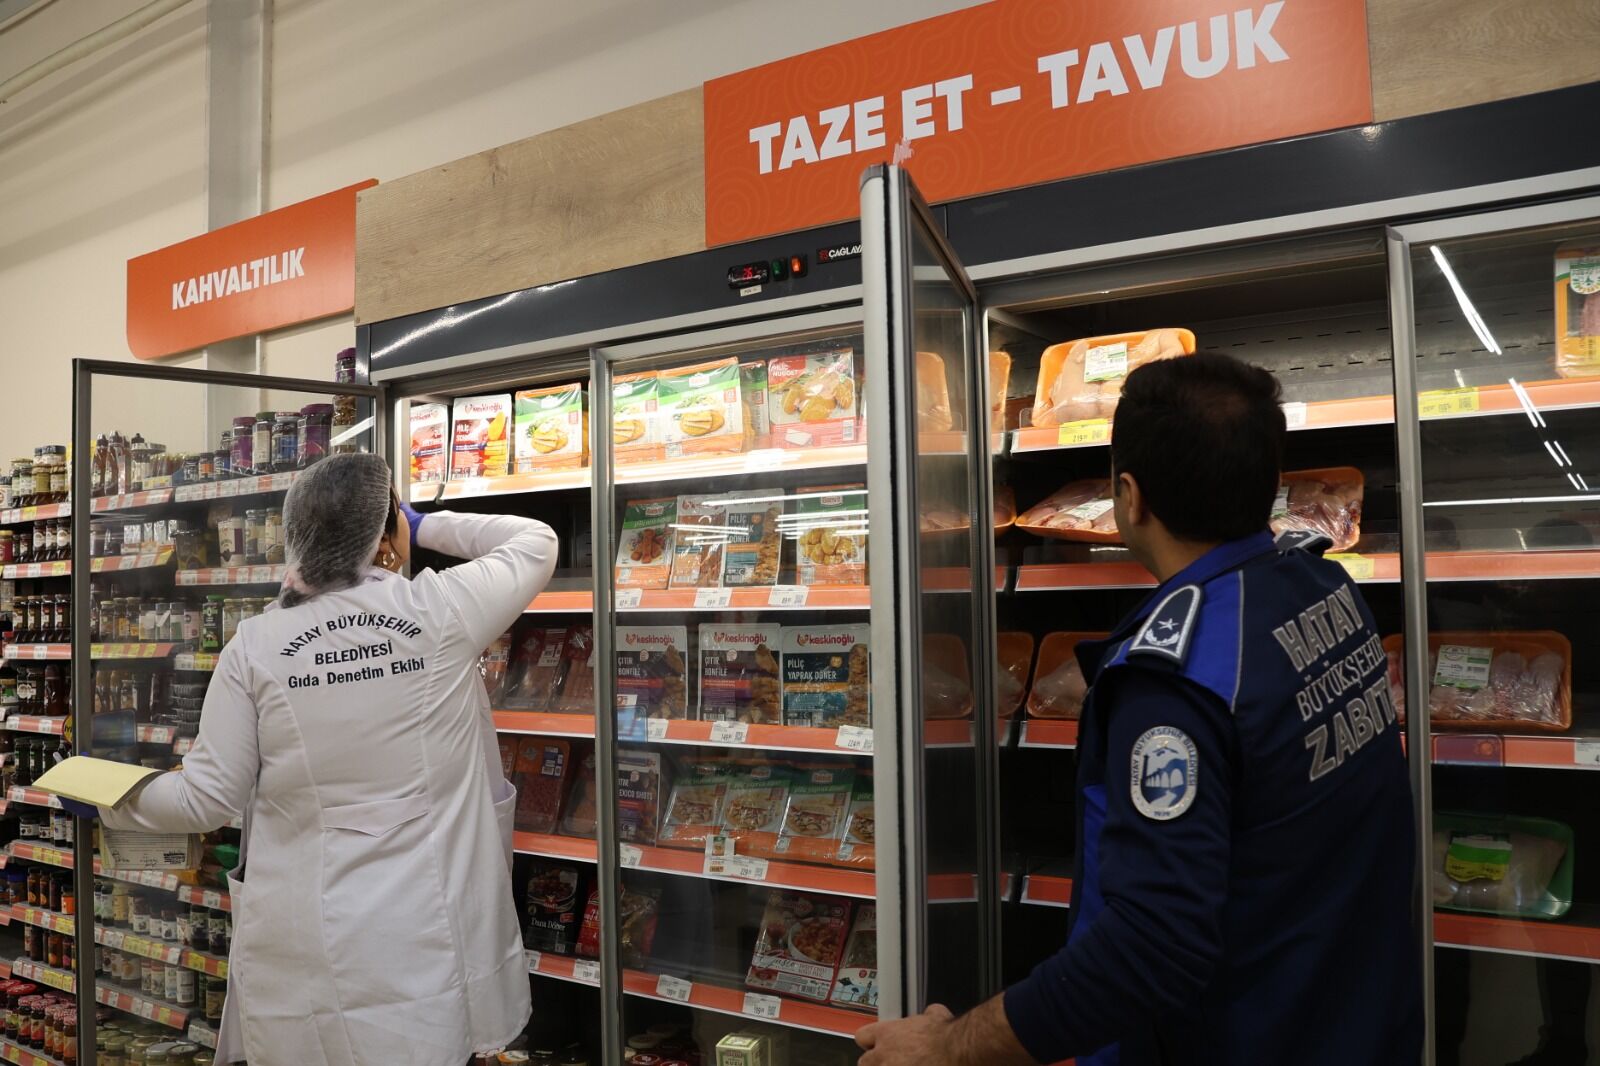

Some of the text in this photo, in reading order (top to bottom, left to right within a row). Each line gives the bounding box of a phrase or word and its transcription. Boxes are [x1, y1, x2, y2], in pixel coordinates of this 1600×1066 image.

[749, 95, 885, 175] TAZE
[901, 73, 974, 141] ET
[1037, 0, 1290, 110] TAVUK
[172, 247, 305, 310] KAHVALTILIK
[280, 612, 422, 657] HATAY BÜYÜKŞEHİR
[724, 632, 767, 645] keskinoğlu
[809, 633, 855, 646] keskinoğlu
[1272, 582, 1364, 673] HATAY
[315, 639, 393, 665] BELEDİYESİ
[787, 657, 805, 670] PİLİÇ
[288, 657, 425, 689] Gıda Denetim Ekibi
[787, 669, 837, 680] YAPRAK DÖNER
